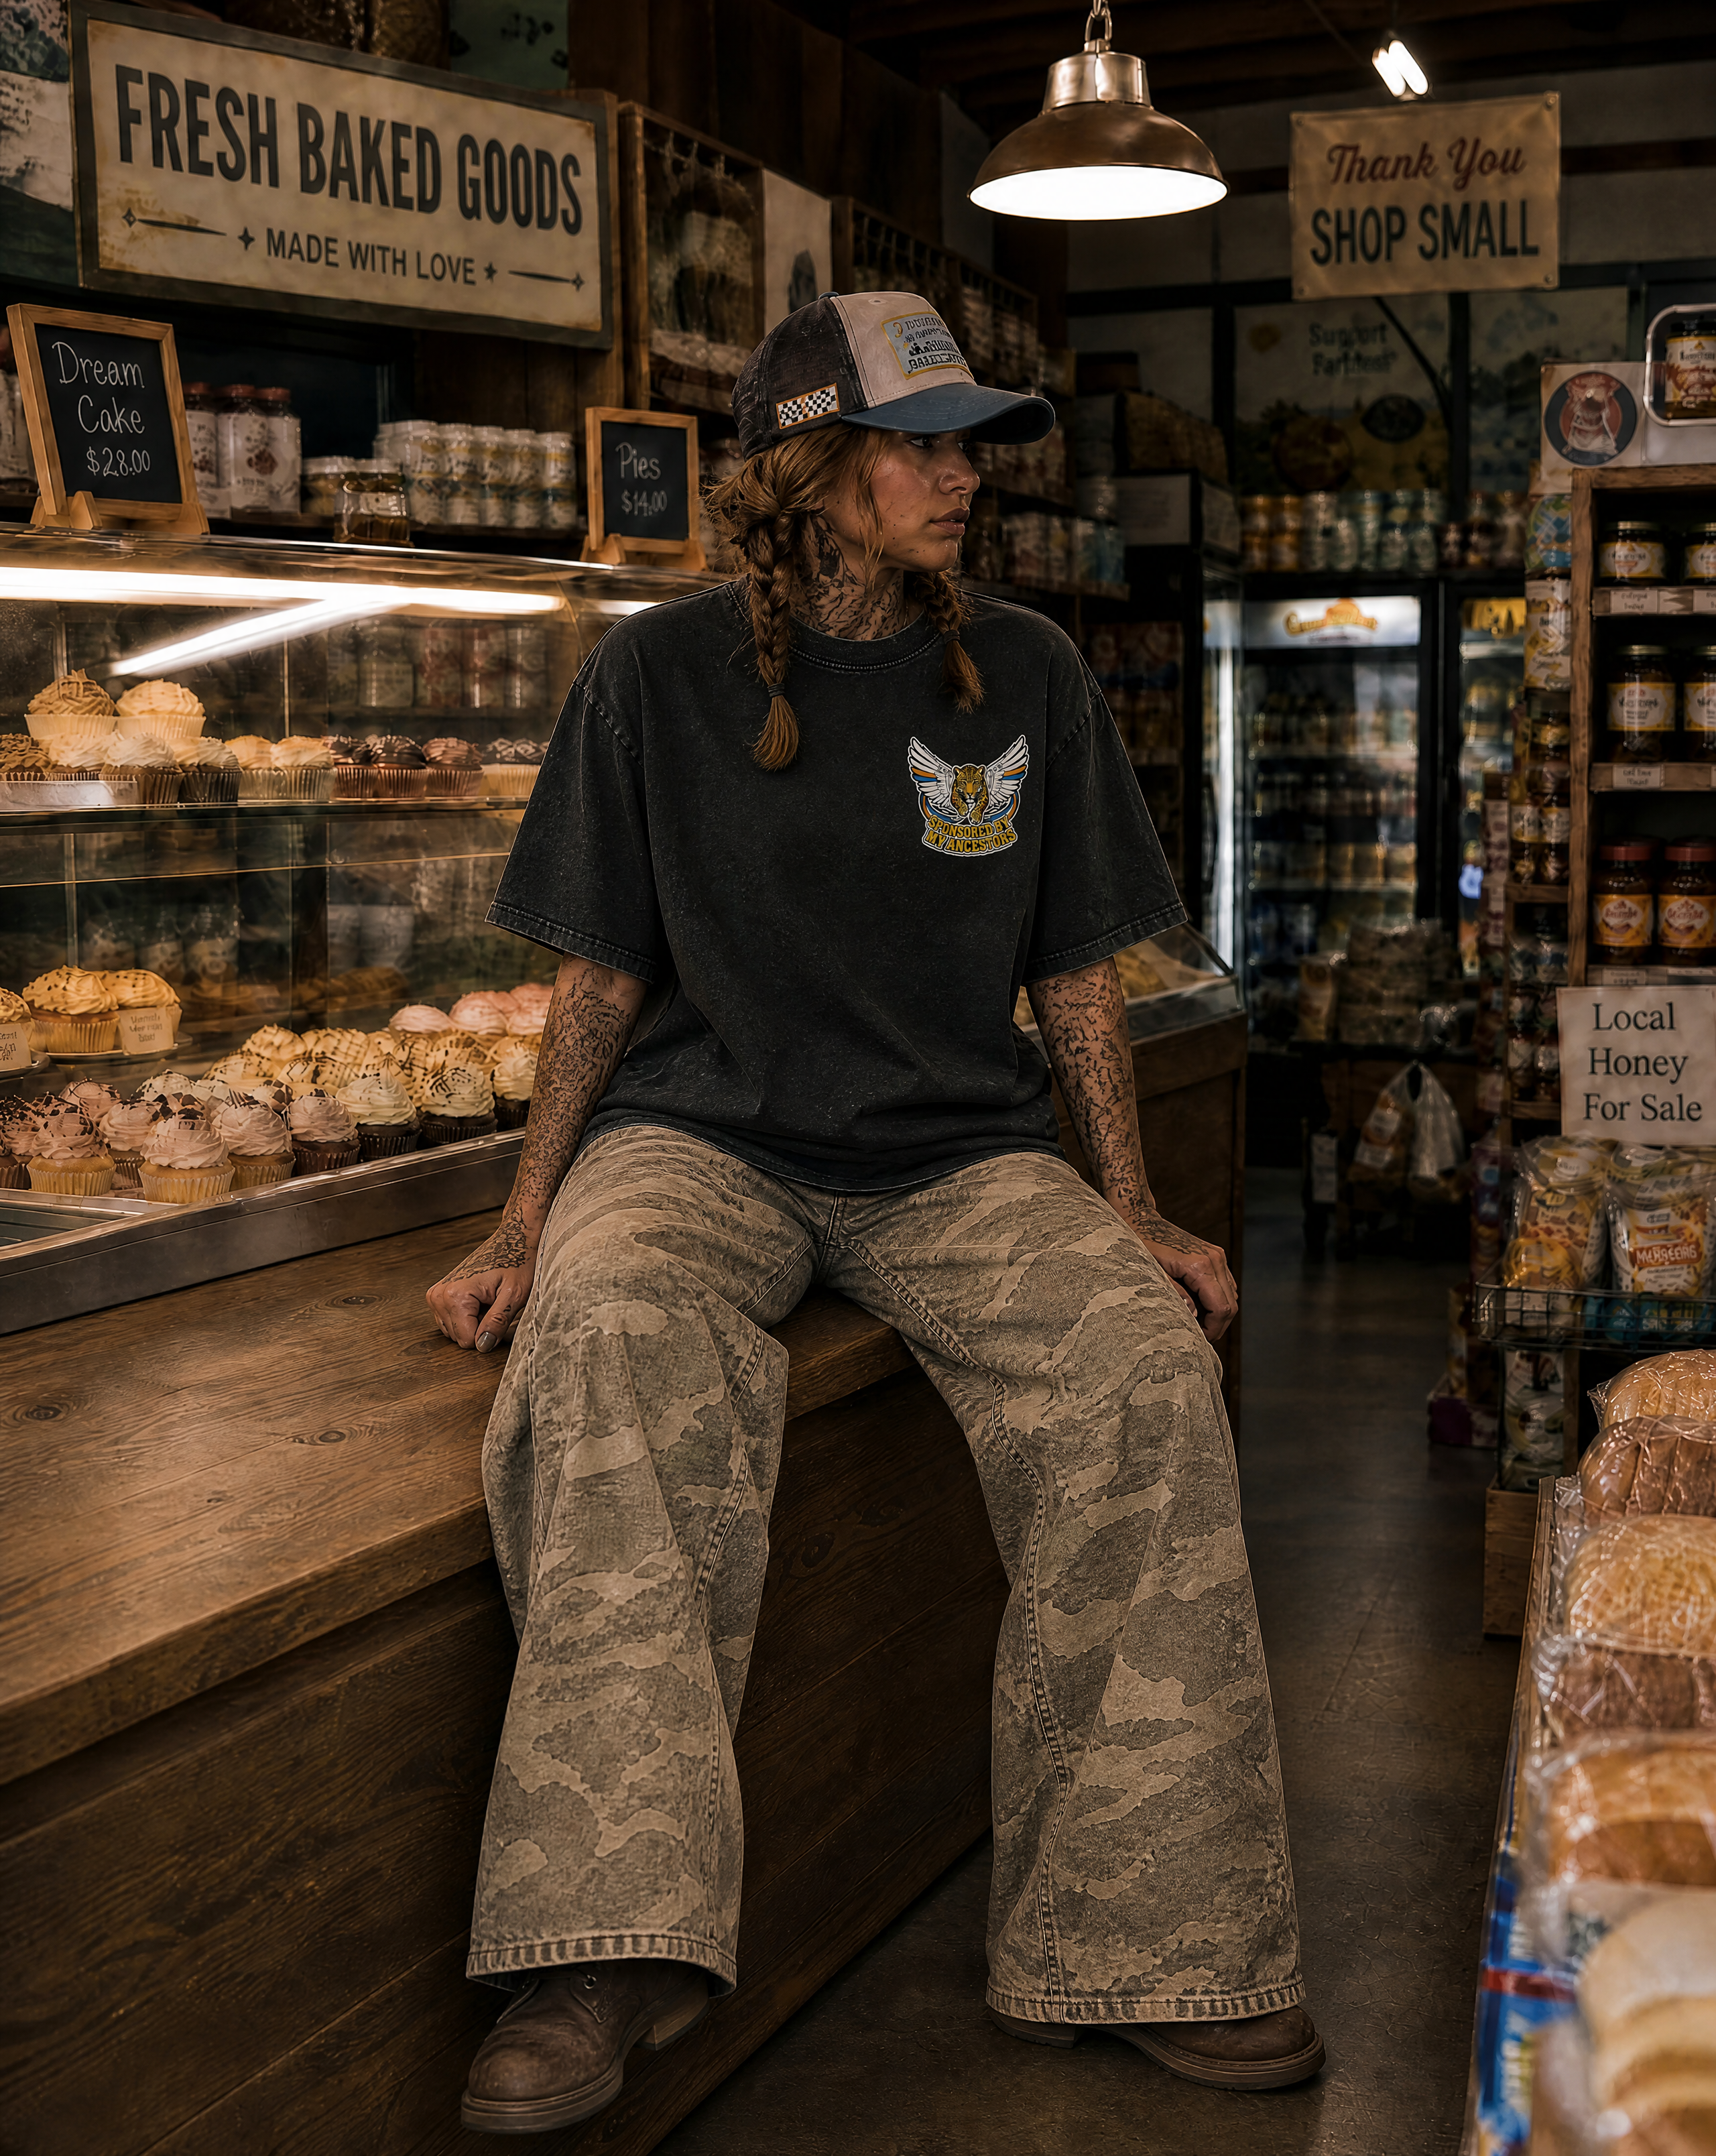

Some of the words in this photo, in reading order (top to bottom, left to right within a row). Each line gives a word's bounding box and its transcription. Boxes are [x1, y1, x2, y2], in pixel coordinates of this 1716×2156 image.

[115, 64, 279, 188] FRESH
[297, 102, 442, 215] BAKED
[457, 133, 583, 236] GOODS
[1327, 141, 1439, 185] Thank
[1447, 136, 1527, 192] You
[1310, 206, 1407, 267] SHOP
[1417, 199, 1540, 261] SMALL
[267, 227, 339, 267] MADE
[347, 241, 407, 278] WITH
[416, 251, 477, 286] LOVE
[52, 341, 145, 388] Dream
[78, 394, 145, 434] Cake
[86, 446, 151, 477] $28.00
[615, 442, 662, 480] Pies
[926, 830, 946, 847] MY
[947, 829, 1016, 852] ANCESTORS
[929, 816, 993, 838] SPONSORED
[994, 815, 1009, 833] BY
[1592, 1002, 1676, 1031] Local
[1588, 1047, 1689, 1085] Honey
[1583, 1092, 1631, 1121] For
[1641, 1093, 1703, 1122] Sale
